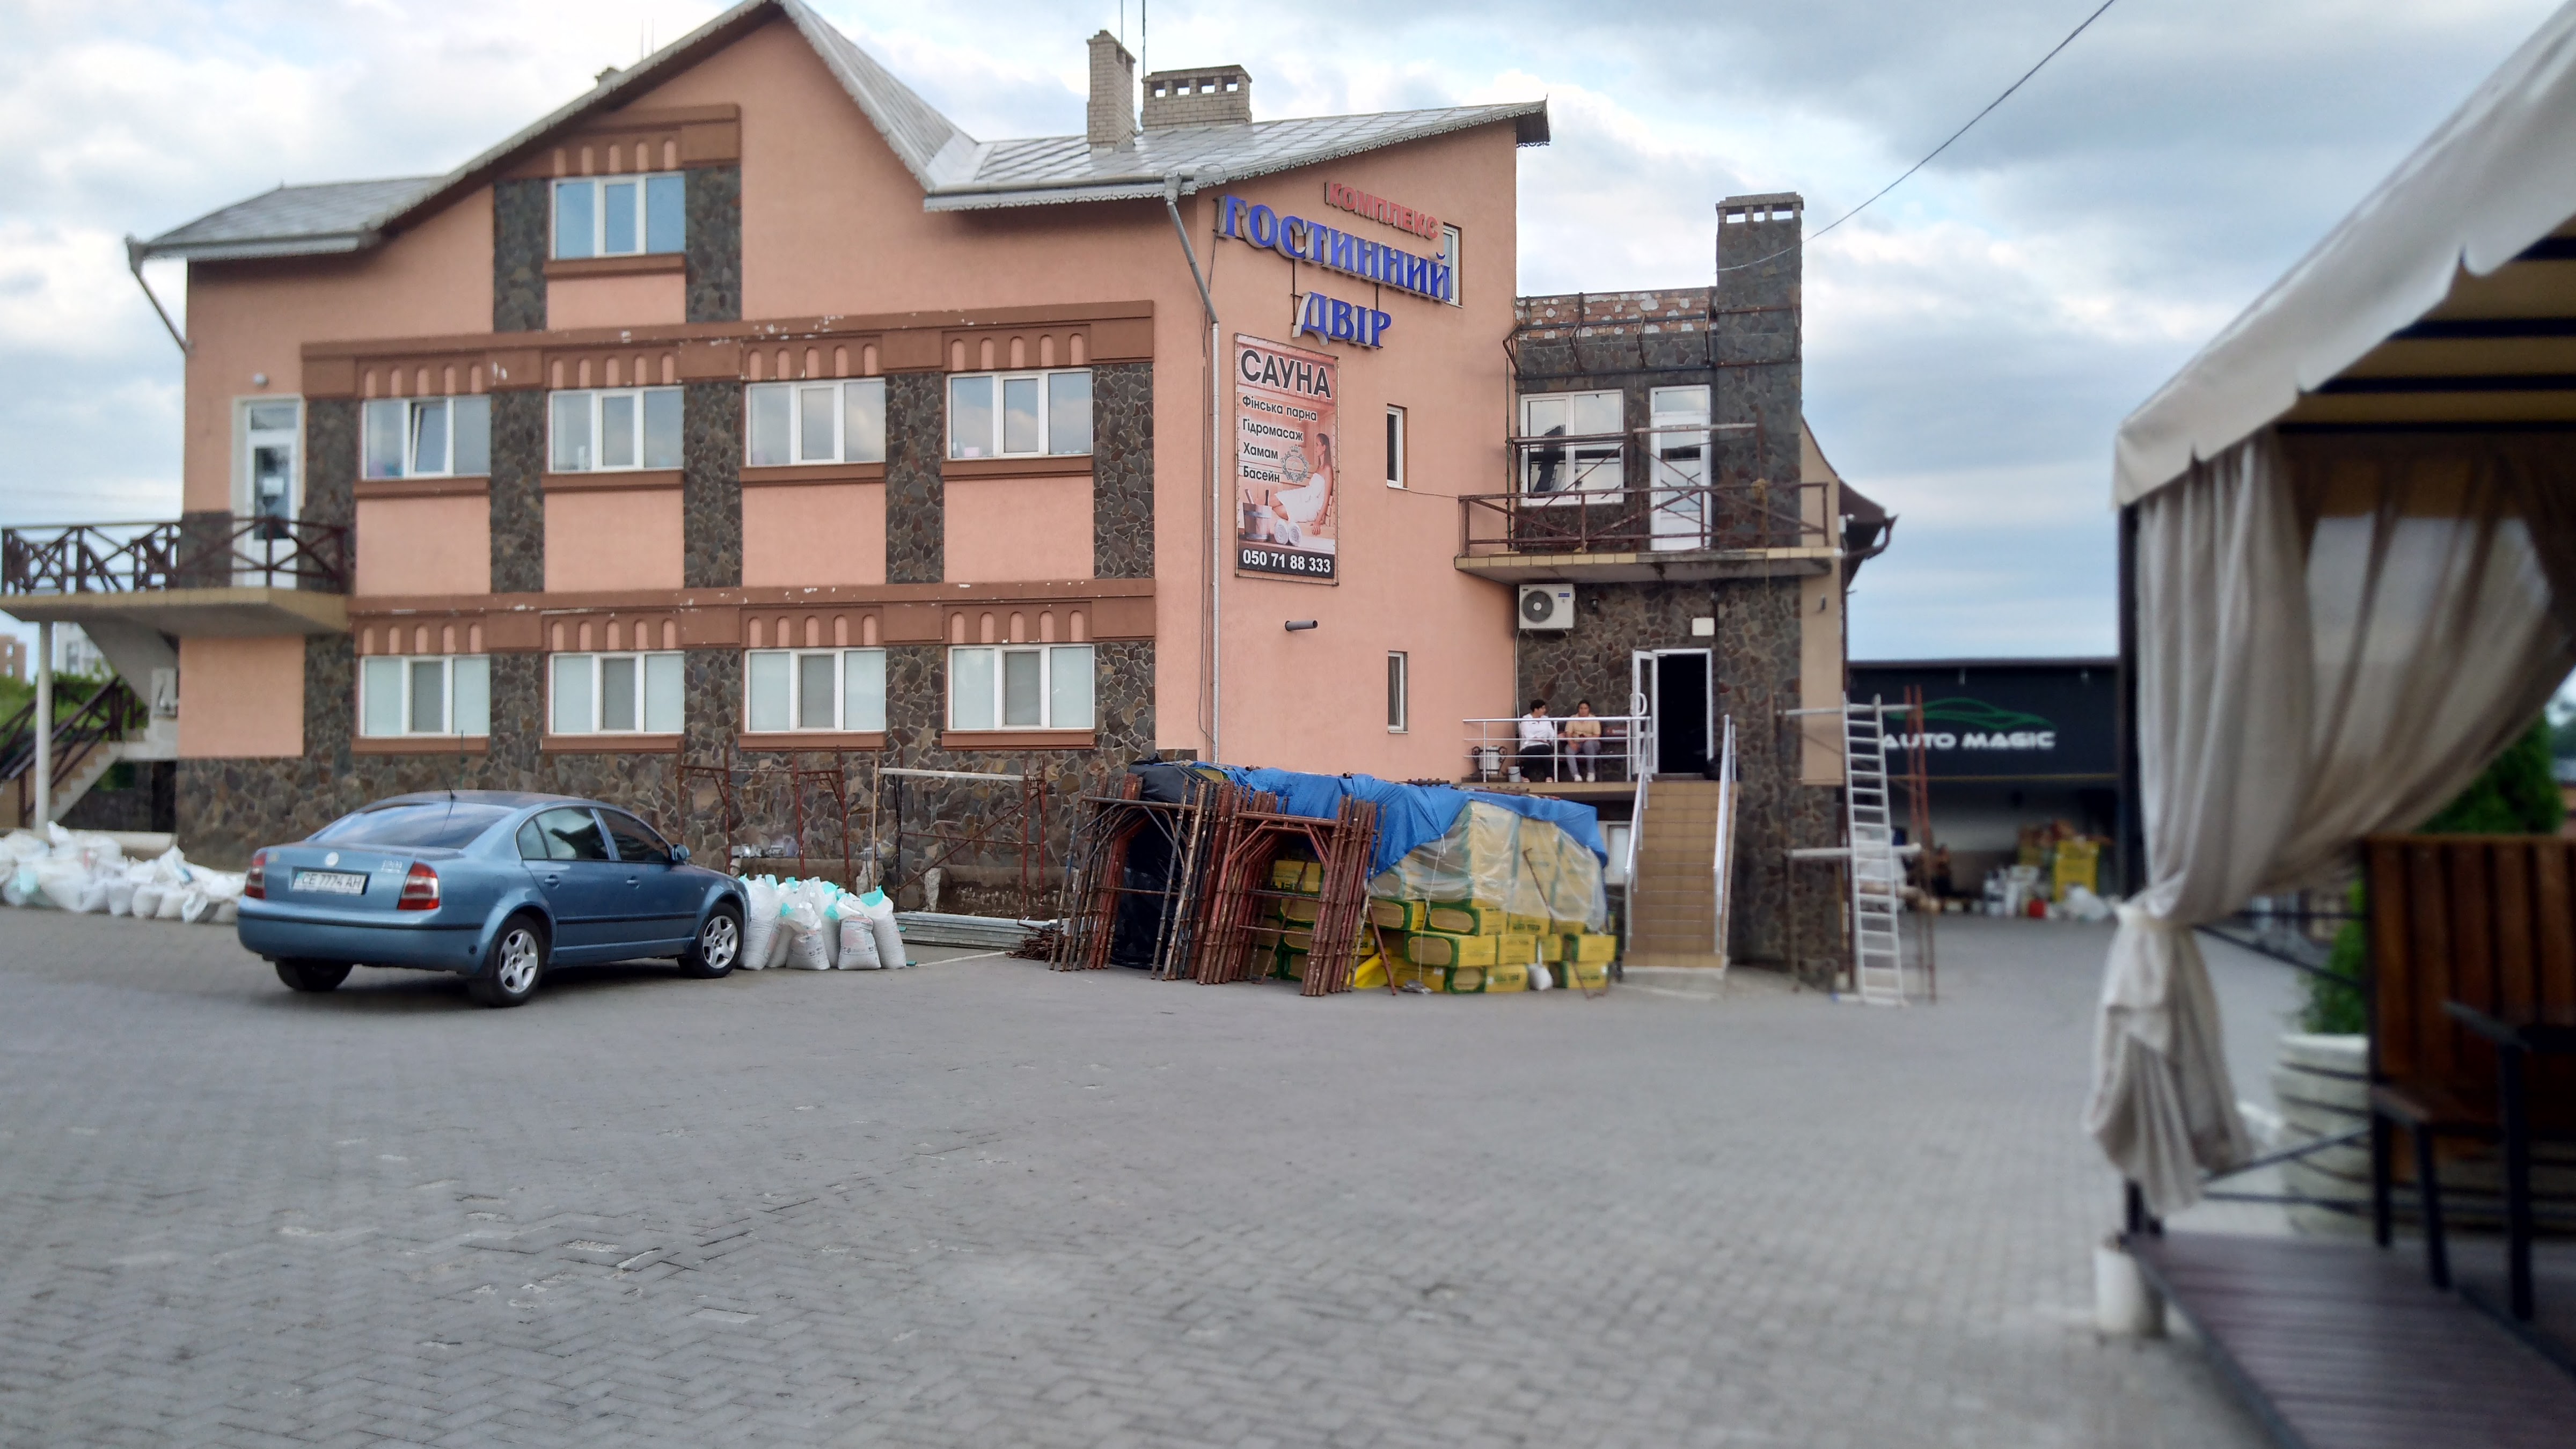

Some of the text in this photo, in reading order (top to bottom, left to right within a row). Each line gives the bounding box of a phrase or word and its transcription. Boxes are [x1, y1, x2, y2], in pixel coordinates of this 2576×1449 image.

[1327, 182, 1438, 239] КОМПЛЕКС
[1217, 195, 1450, 302] ГОСТИННИЙ
[1292, 291, 1392, 348] ДВІР
[1241, 349, 1331, 398] САУНА
[1242, 395, 1317, 421] Фінська парна
[1242, 418, 1304, 442] Гідромасаж
[1243, 442, 1278, 459] Хамам
[1243, 465, 1280, 483] Басейн
[1243, 549, 1331, 573] 050 71 88 333
[1883, 730, 2057, 749] AUTO MAGIC
